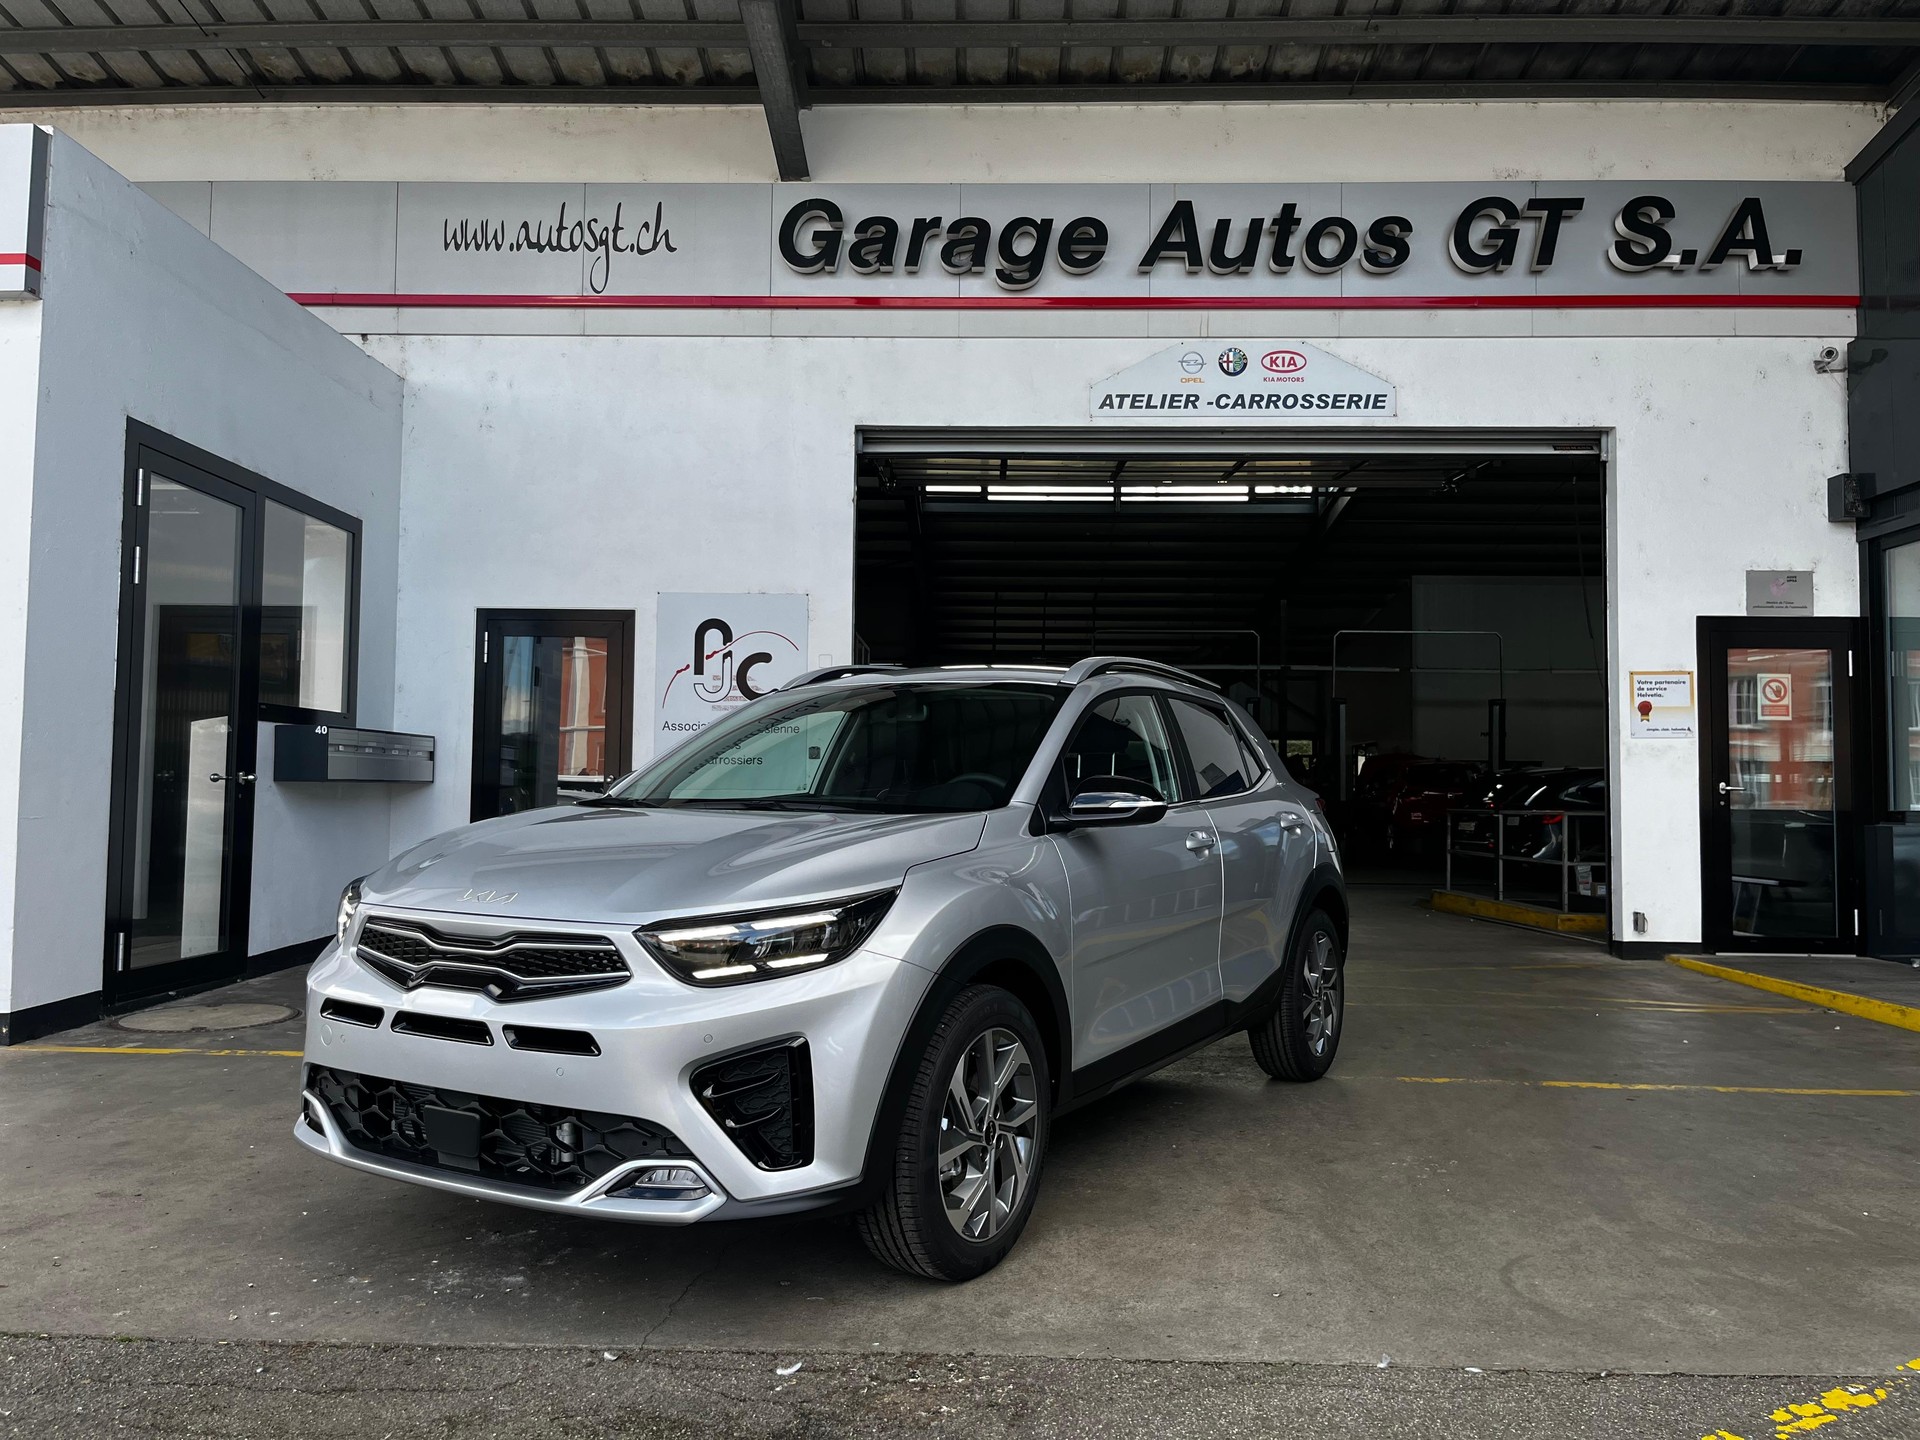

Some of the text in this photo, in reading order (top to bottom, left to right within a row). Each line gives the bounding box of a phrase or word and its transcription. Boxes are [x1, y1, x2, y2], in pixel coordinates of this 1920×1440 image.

[443, 201, 678, 294] www.autosgt.ch
[778, 195, 1804, 291] Garage Autos GT S.A.
[1269, 356, 1298, 368] KIA
[1098, 393, 1388, 410] ATELIER -CARROSSERIE
[315, 725, 328, 735] 40
[662, 720, 711, 732] Associ
